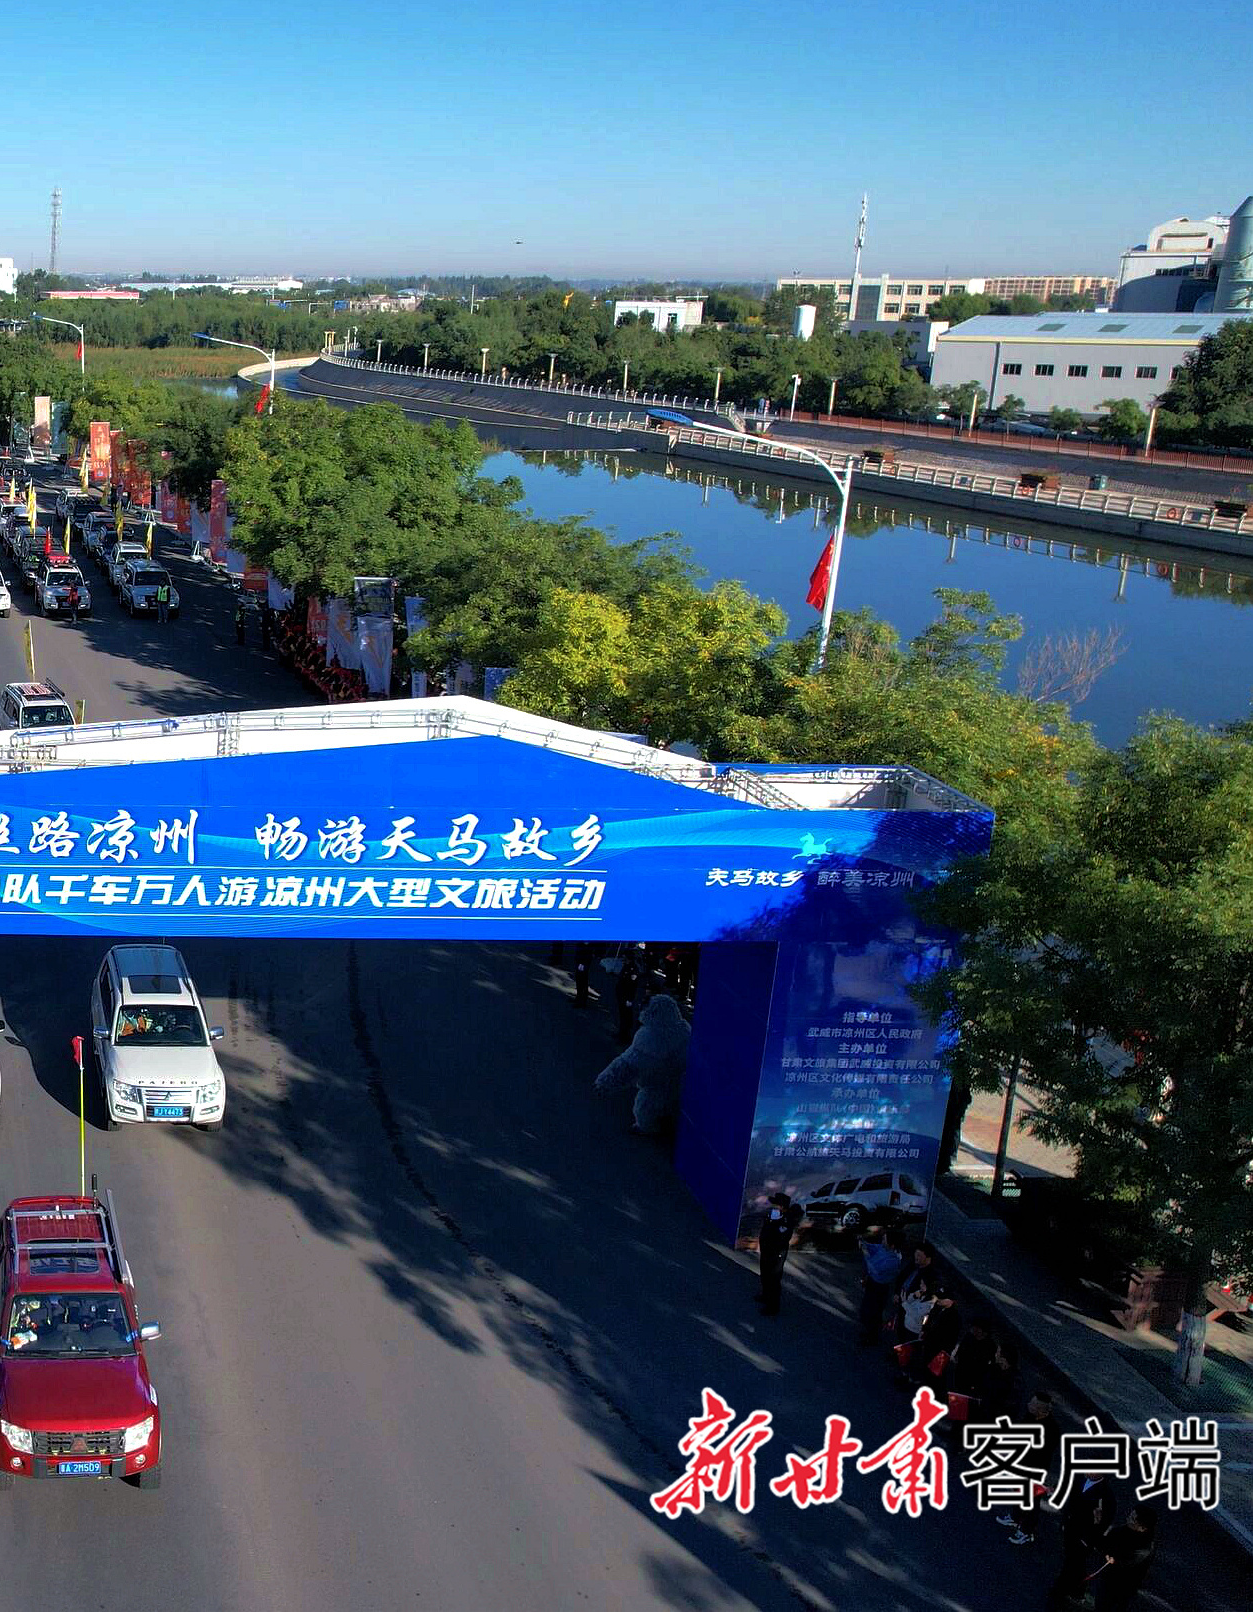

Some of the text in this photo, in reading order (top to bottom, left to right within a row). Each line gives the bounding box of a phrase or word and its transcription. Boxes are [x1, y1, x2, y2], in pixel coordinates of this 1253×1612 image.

[255, 810, 608, 867] 畅游天马故乡
[705, 868, 915, 888] 天马故乡 醉美凉州
[842, 1011, 893, 1024] 指导单位
[807, 1027, 923, 1040] 武威市凉州区人民政府
[837, 1043, 888, 1055] 主办单位
